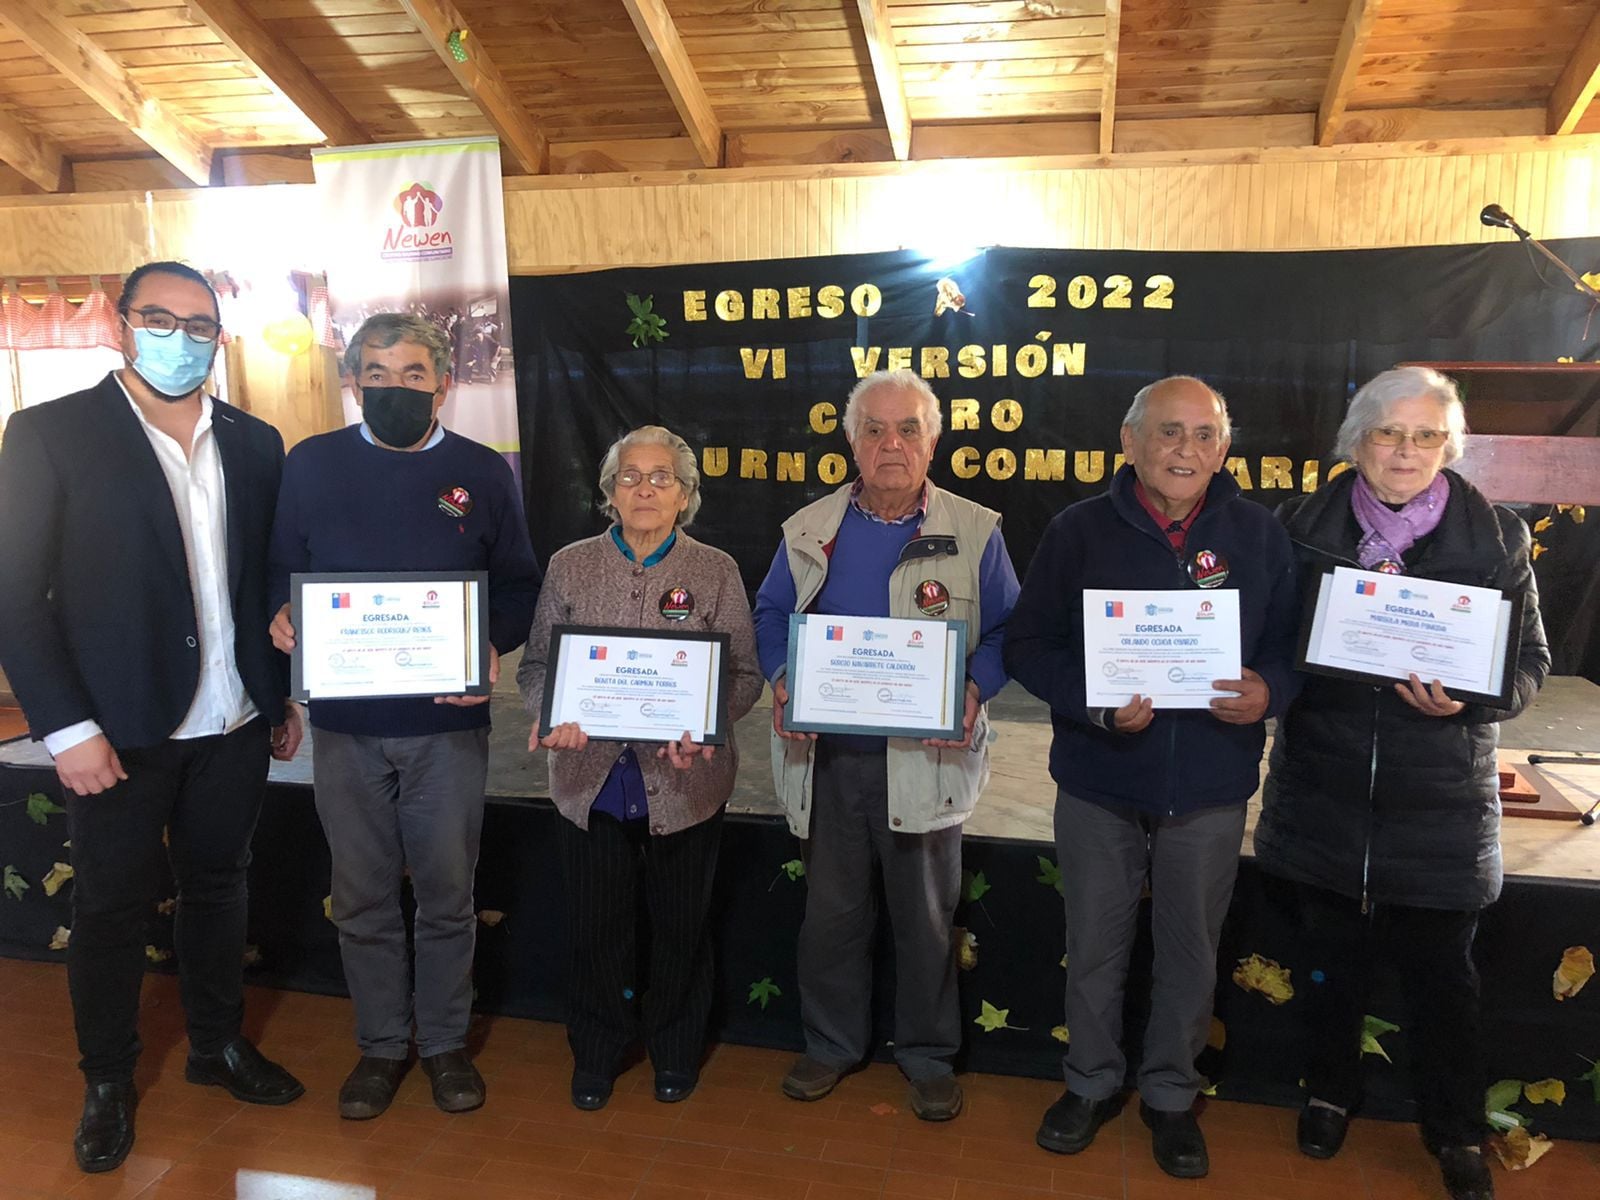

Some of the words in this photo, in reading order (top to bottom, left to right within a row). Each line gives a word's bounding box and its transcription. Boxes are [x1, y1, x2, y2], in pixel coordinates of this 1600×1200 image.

[383, 225, 452, 250] Newen
[683, 283, 882, 322] EGRESO
[1027, 274, 1176, 310] 2022
[739, 347, 787, 380] VI
[850, 330, 1086, 379] VERSIÓN
[808, 398, 1024, 435] CRO
[362, 612, 410, 622] EGRESADA
[1385, 603, 1435, 619] EGRESADA
[1135, 624, 1183, 633] EGRESADA
[852, 647, 895, 658] EGRESADA
[616, 667, 658, 675] EGRESADA
